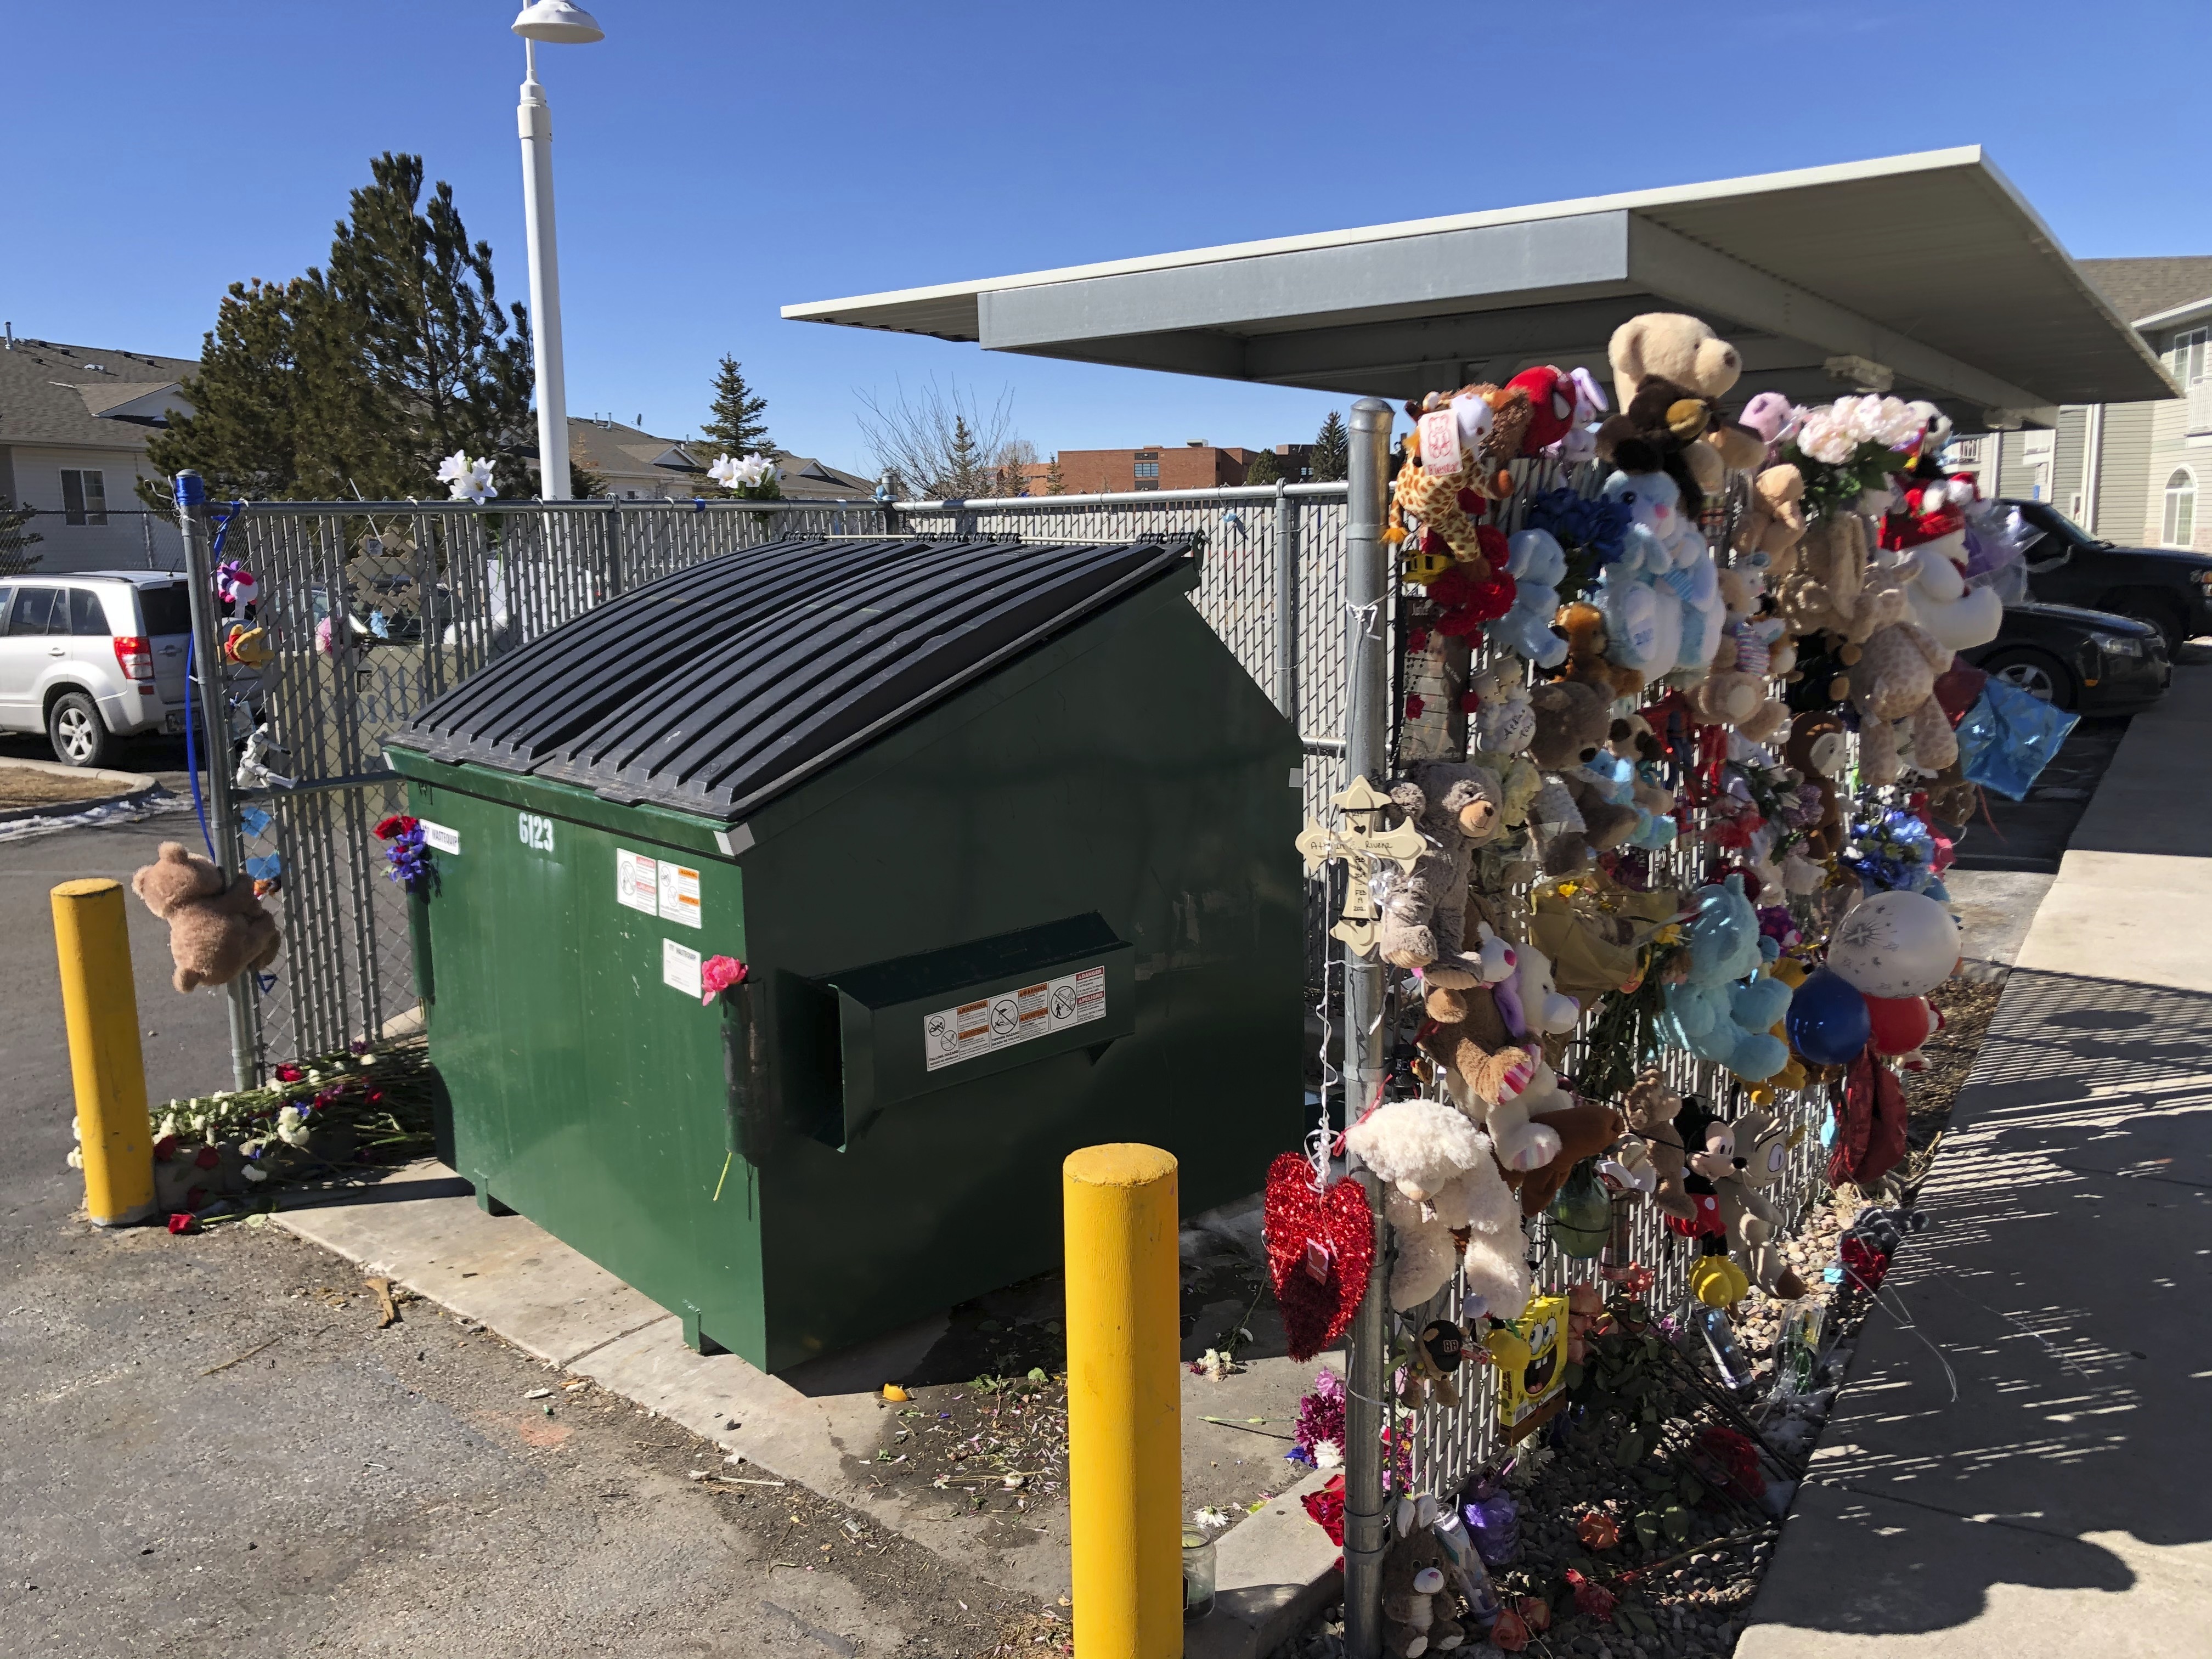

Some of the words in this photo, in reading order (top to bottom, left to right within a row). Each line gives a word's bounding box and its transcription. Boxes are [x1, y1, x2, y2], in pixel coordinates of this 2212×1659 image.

[1427, 461, 1459, 475] Fiesta
[518, 811, 554, 852] 6123
[432, 829, 458, 847] WASTEQUIP
[1081, 969, 1102, 979] DANGER
[1024, 985, 1046, 995] WARNING
[1081, 992, 1103, 1003] PELIGRO
[962, 1002, 987, 1012] WARNING
